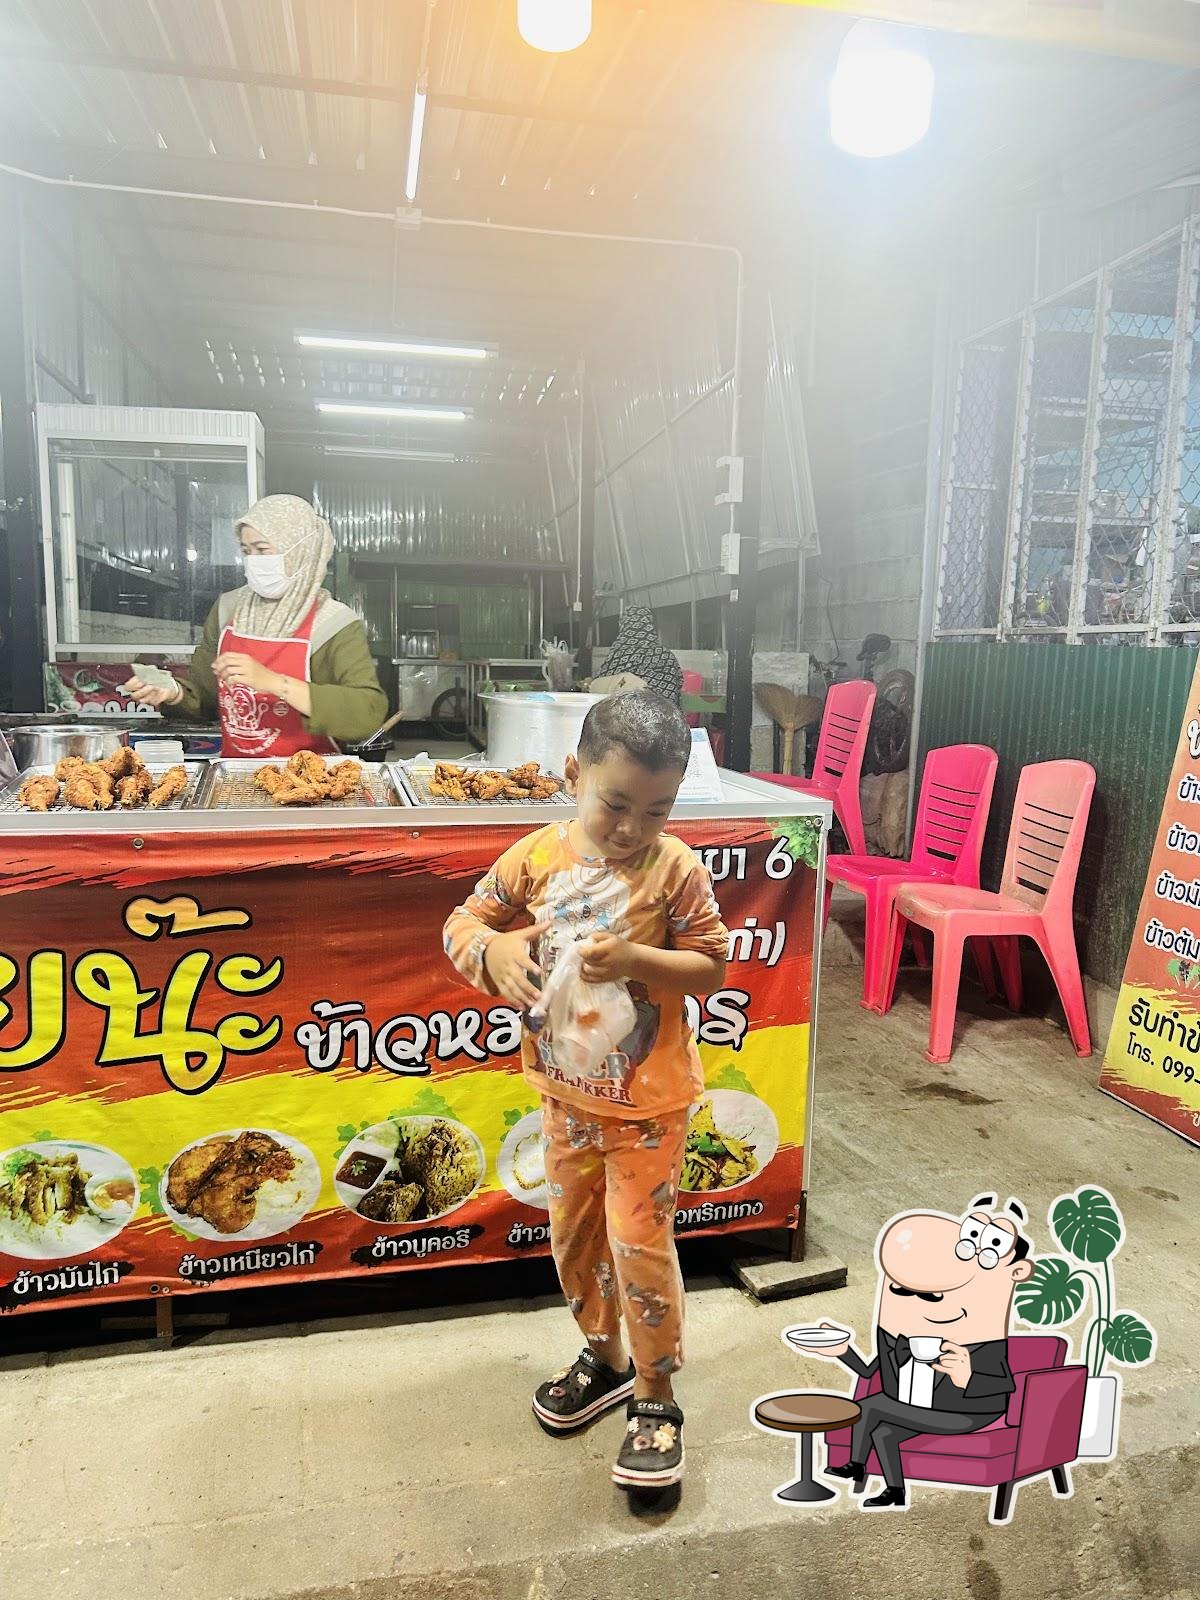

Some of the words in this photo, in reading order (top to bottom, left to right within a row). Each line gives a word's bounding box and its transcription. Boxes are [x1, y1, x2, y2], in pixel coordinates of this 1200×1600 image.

[1167, 823, 1200, 854] ข้าว
[765, 836, 793, 880] 6
[508, 1222, 551, 1243] ข้าว
[12, 1261, 119, 1295] ข้าวมันไก่
